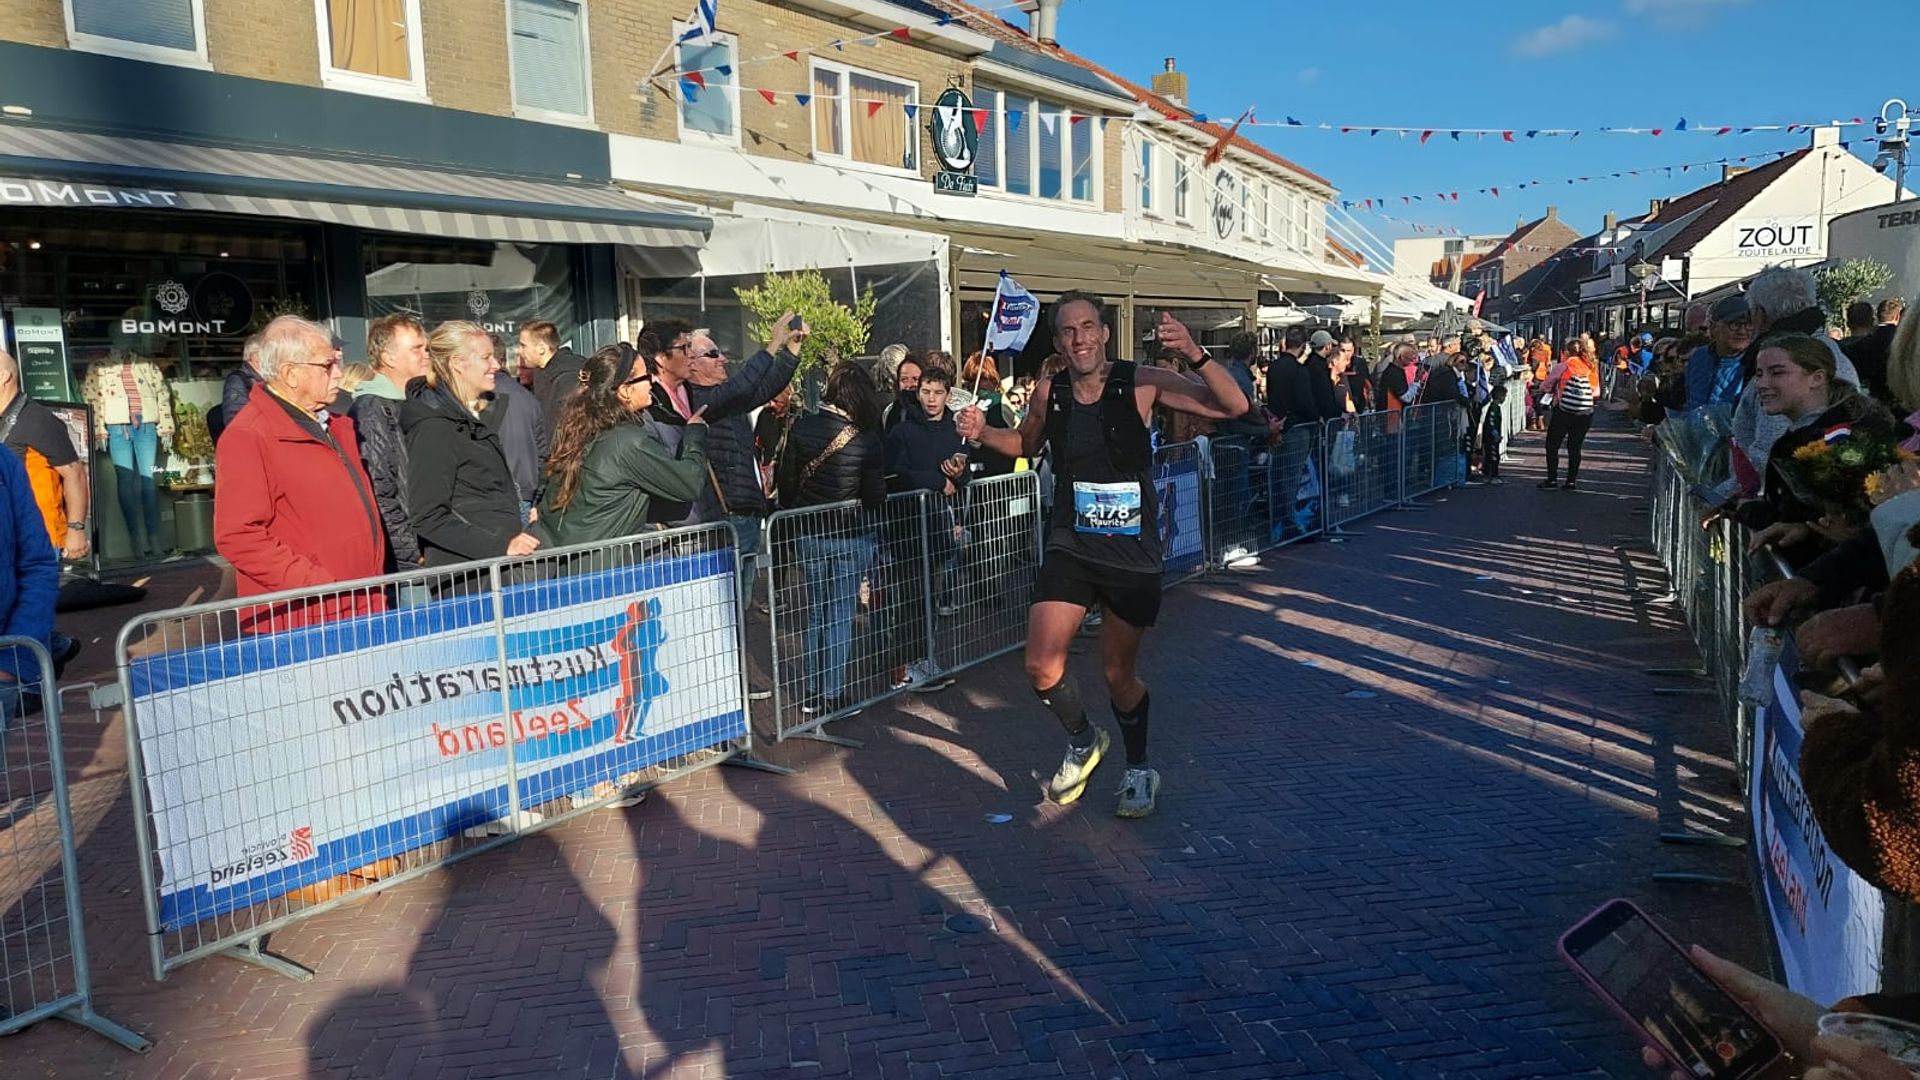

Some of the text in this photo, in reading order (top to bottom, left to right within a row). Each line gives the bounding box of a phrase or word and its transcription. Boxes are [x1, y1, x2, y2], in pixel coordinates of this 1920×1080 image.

[1739, 226, 1813, 248] ZOUT
[1738, 246, 1811, 257] ZOUTELANDE
[483, 320, 515, 333] ONT
[1085, 503, 1130, 519] 2178
